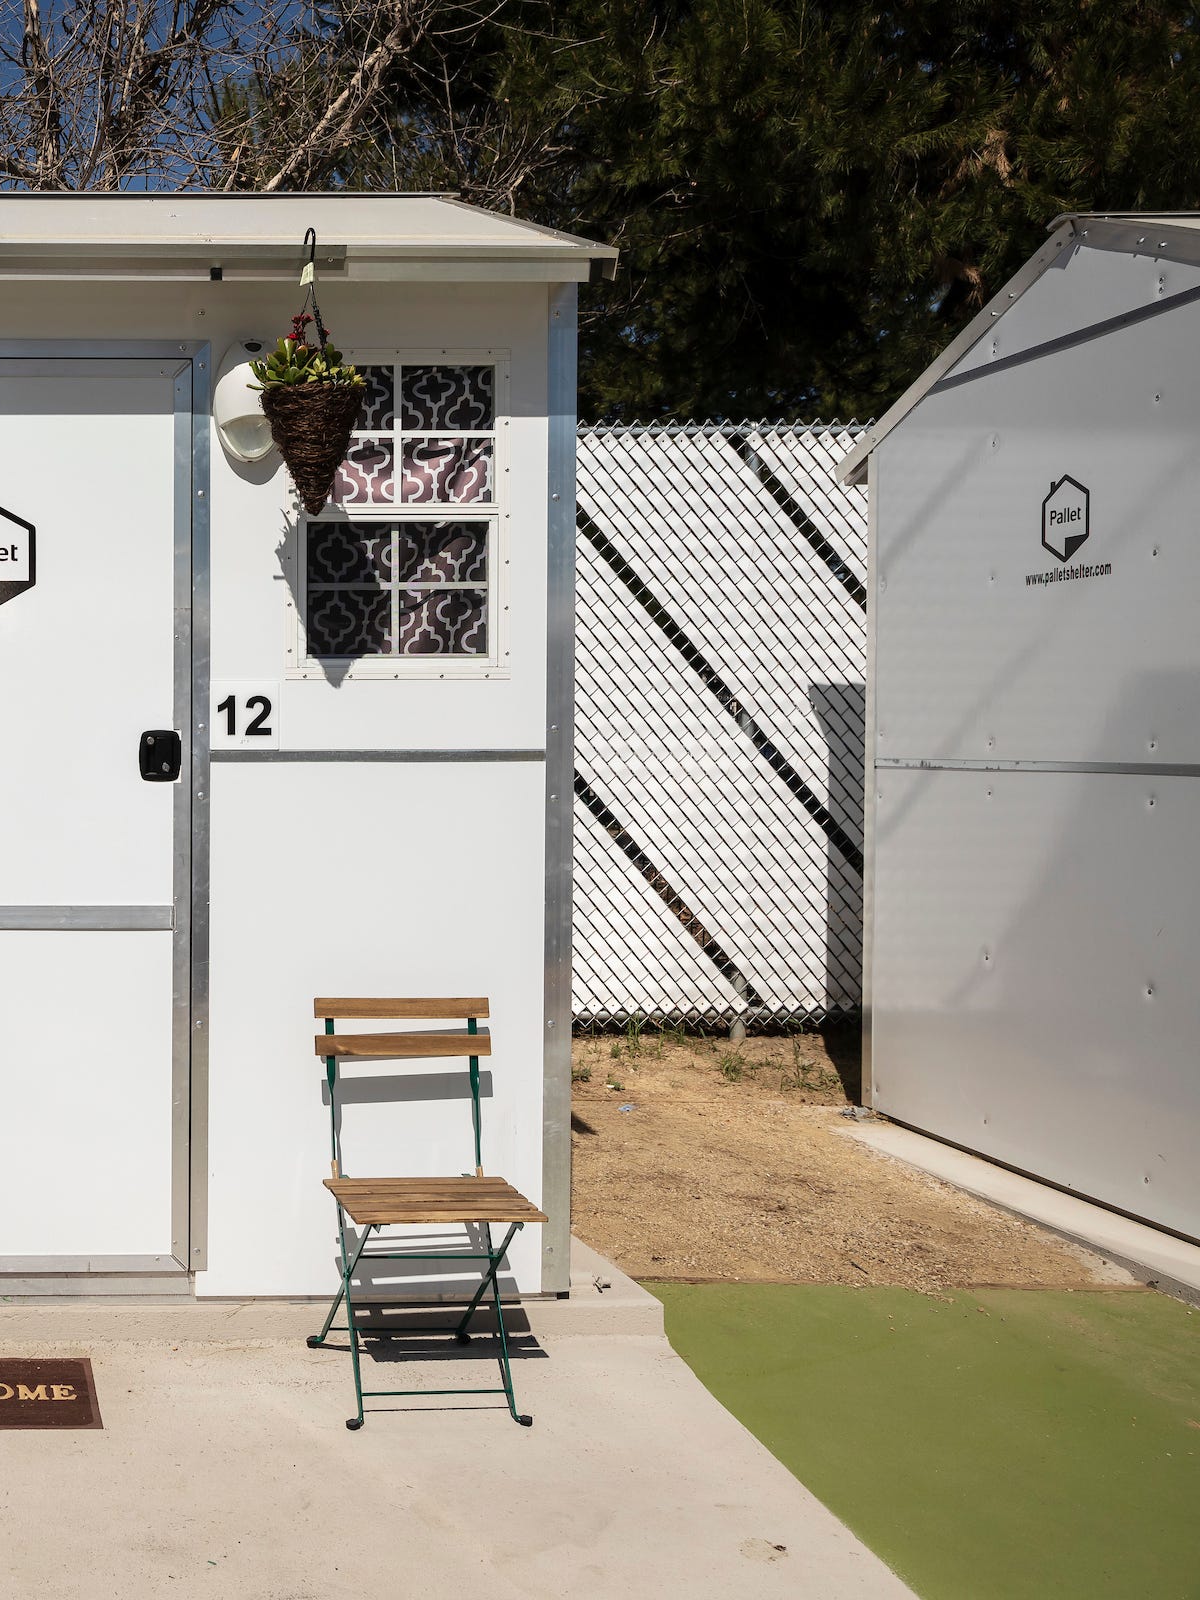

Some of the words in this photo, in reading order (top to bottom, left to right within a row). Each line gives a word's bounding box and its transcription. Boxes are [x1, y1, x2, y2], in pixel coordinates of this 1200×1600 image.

[1050, 507, 1081, 526] Pallet
[1025, 563, 1112, 587] www.palletshelter.com
[217, 695, 272, 736] 12
